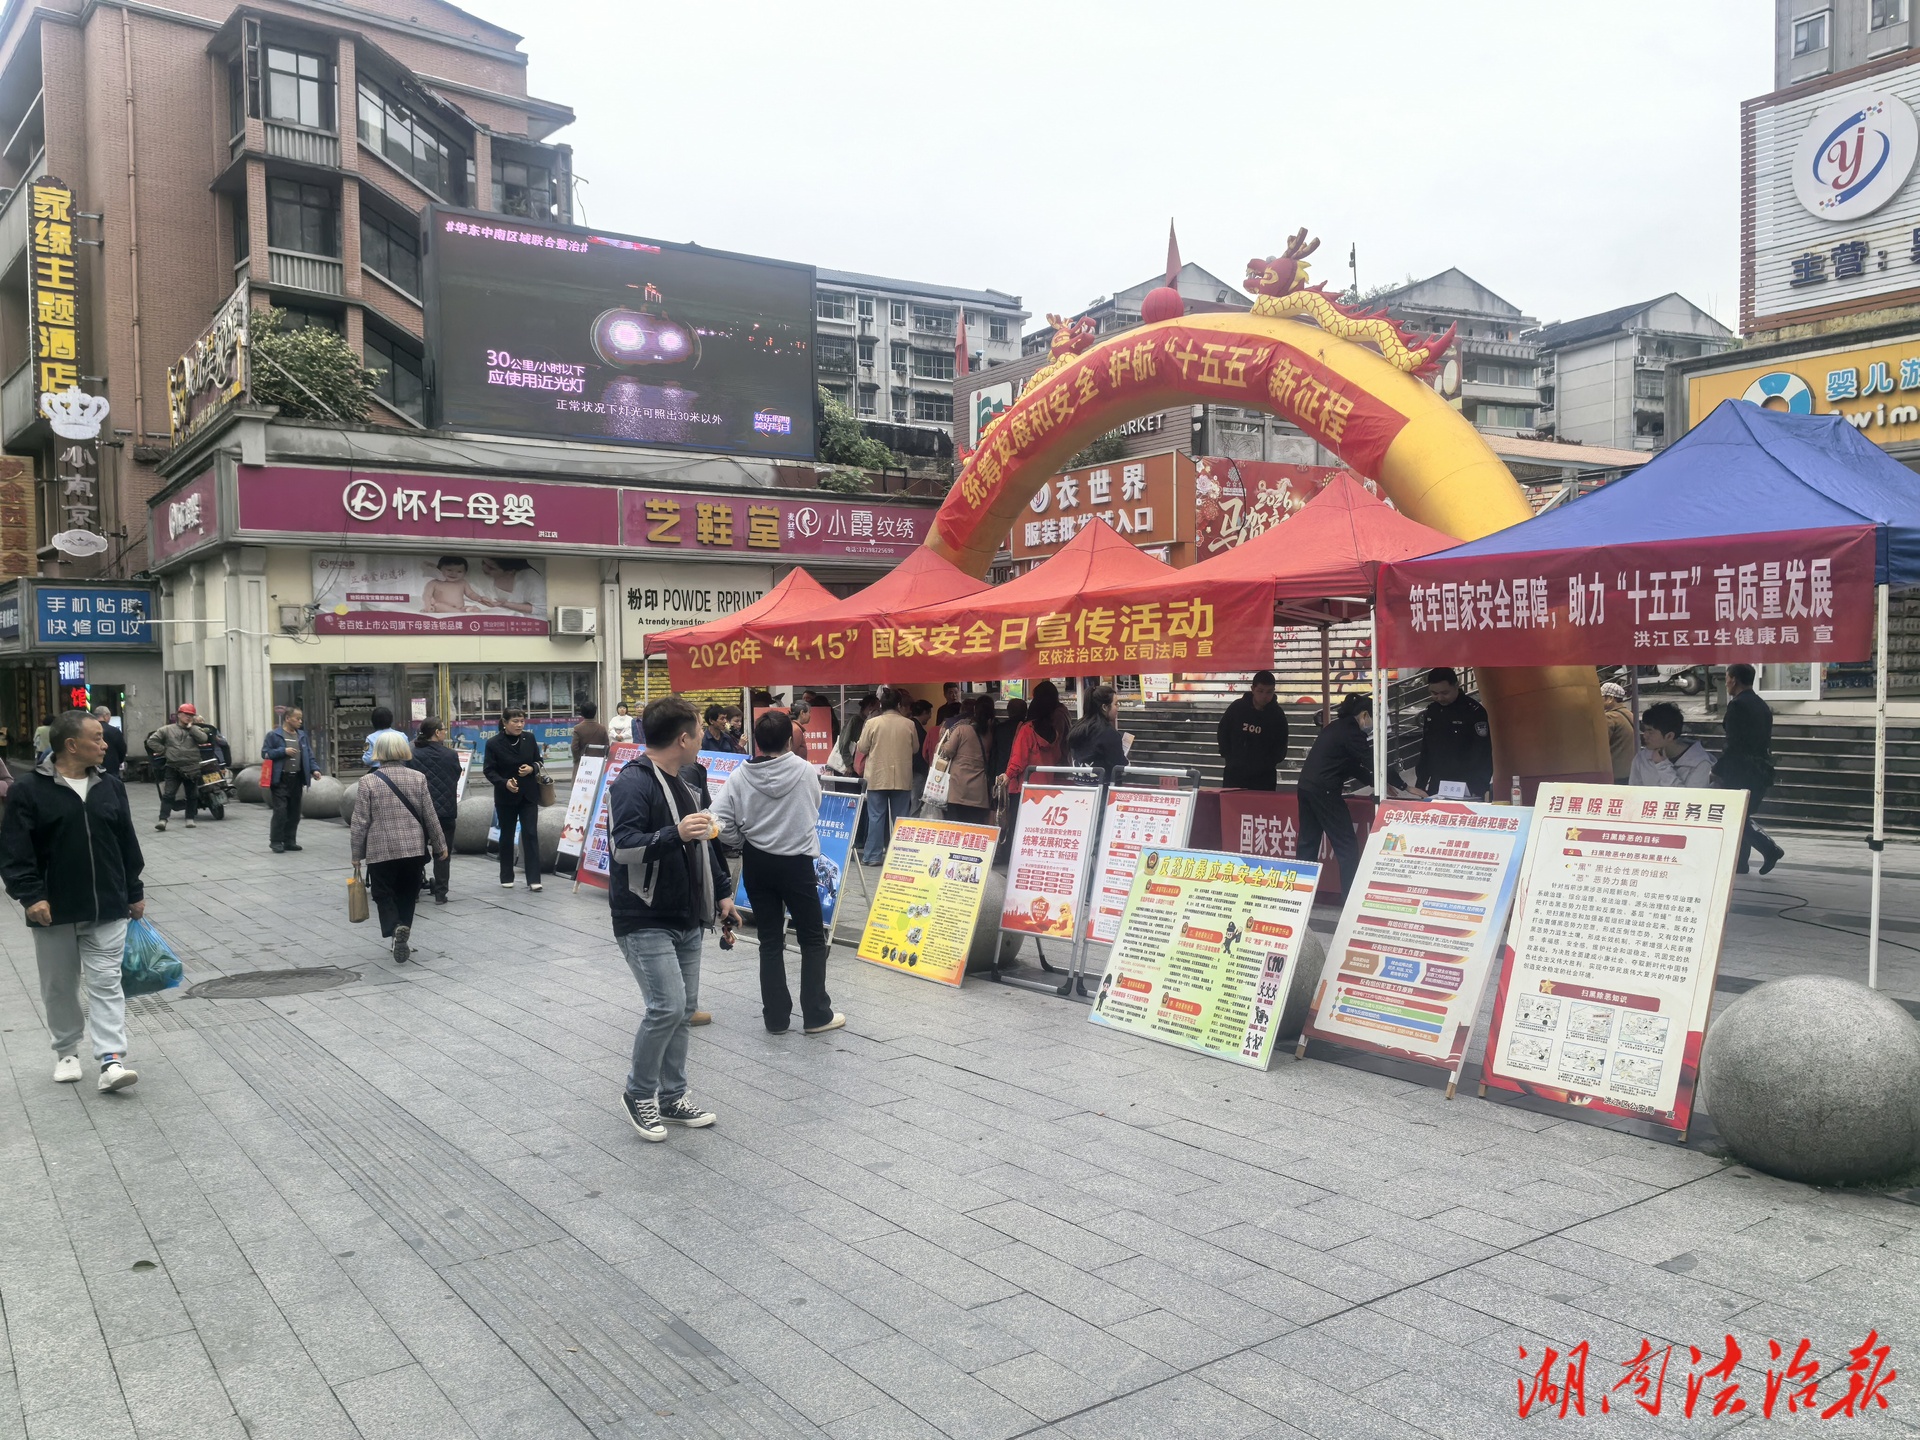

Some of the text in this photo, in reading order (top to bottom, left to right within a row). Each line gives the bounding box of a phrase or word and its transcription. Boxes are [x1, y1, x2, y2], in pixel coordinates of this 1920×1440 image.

[445, 220, 588, 253] #华东中南区域联合整治#
[33, 184, 77, 391] 家缘主题酒店
[486, 350, 585, 375] 30公里/小时以下
[488, 369, 585, 393] 应使用近光灯
[556, 398, 722, 425] 正常状况下灯光可照出30米以外
[1828, 403, 1918, 428] wim
[961, 367, 1099, 510] 统筹发展和安全
[59, 446, 98, 525] 小南京
[1056, 463, 1147, 511] 衣世界
[392, 487, 535, 527] 怀仁母婴
[645, 499, 780, 549] 艺鞋堂
[828, 509, 914, 539] 小霞纹绣
[627, 588, 658, 611] 粉印
[663, 589, 712, 612] POWDE
[48, 619, 140, 636] 快修回收
[638, 617, 644, 625] A
[645, 618, 669, 626] trendy
[671, 618, 693, 626] brand
[1633, 624, 1834, 648] 洪江区卫生健康局 宣
[1038, 640, 1213, 667] 区依法治区办 区司法局 宣
[1384, 810, 1519, 831] 中华人民共和国反有组织犯罪法
[1549, 795, 1726, 823] 扫黑除恶 除恶务尽
[1022, 835, 1079, 850] 统筹发展和安全
[1602, 832, 1661, 845] 扫黑除恶的目标
[1591, 849, 1678, 863] 扫黑除恶中的恶和黑是什么
[1158, 856, 1297, 891] 反恐防暴应急安全知识
[1581, 989, 1627, 1004] 扫黑除恶知识
[1604, 1096, 1674, 1119] 洪江区公安局 宣
